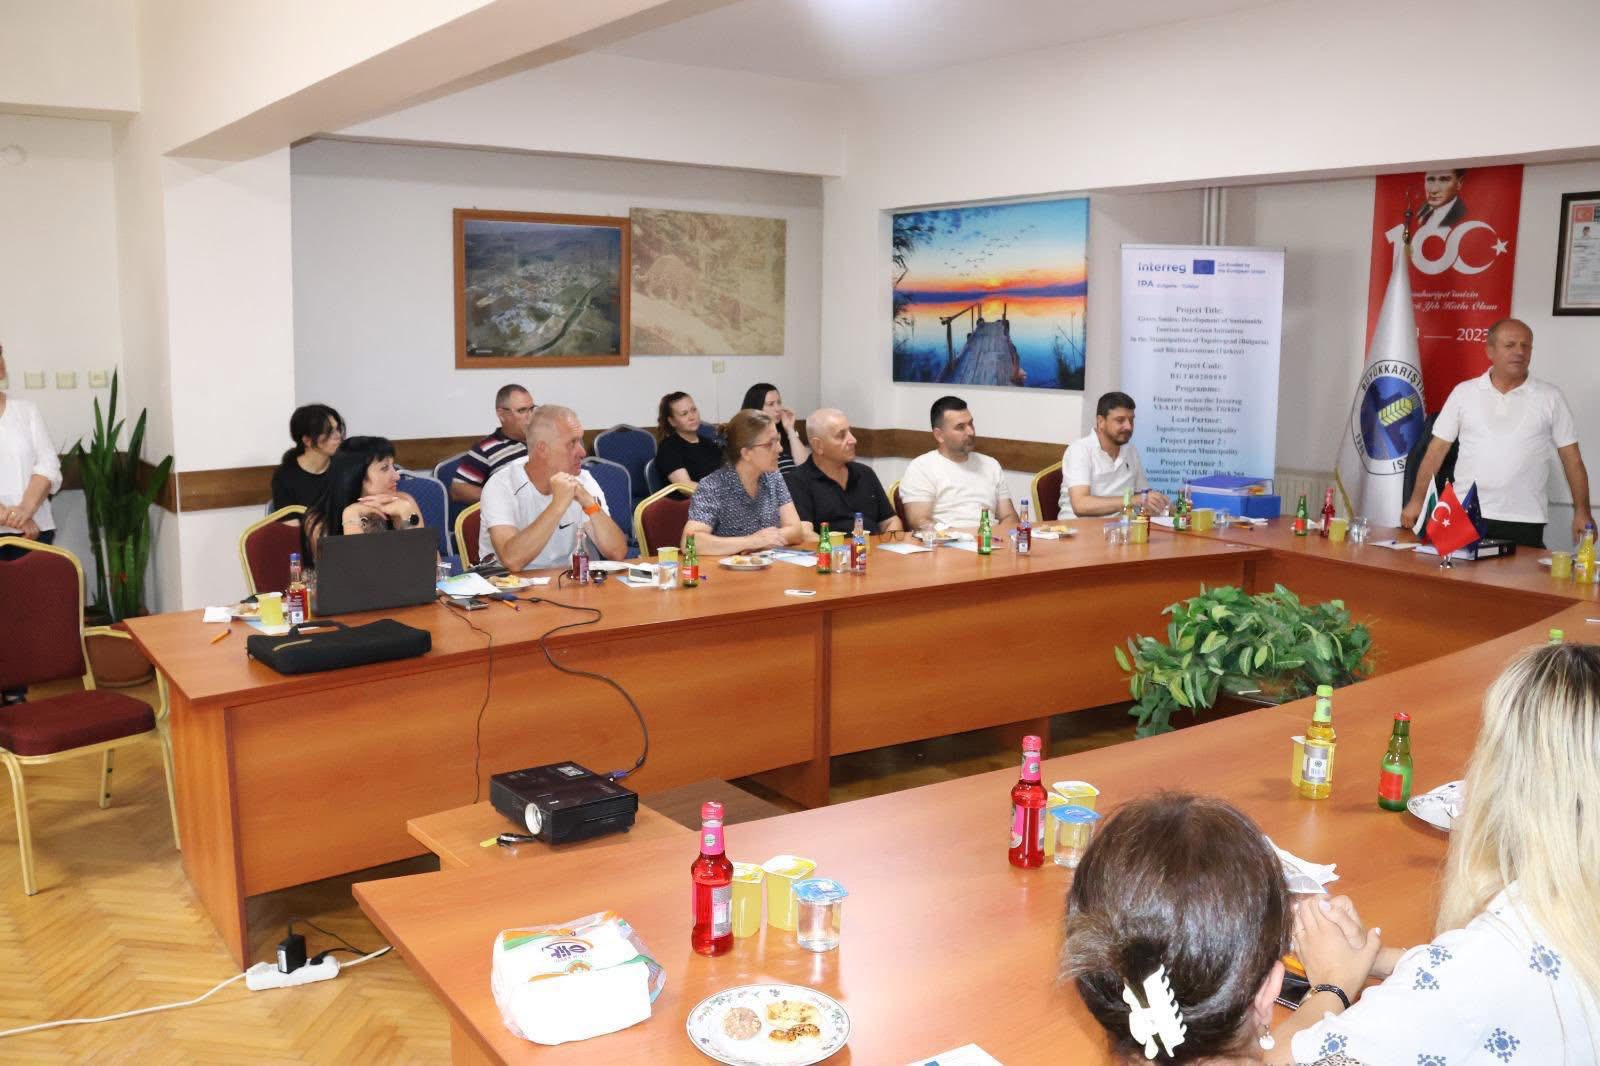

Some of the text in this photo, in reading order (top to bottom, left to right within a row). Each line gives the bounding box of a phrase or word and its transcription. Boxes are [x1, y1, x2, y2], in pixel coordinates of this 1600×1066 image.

[1176, 306, 1202, 315] Project
[1174, 361, 1200, 370] Project
[1171, 415, 1190, 423] Lead
[1160, 437, 1186, 445] Project
[1160, 458, 1186, 467] Project
[1188, 459, 1215, 467] Partner
